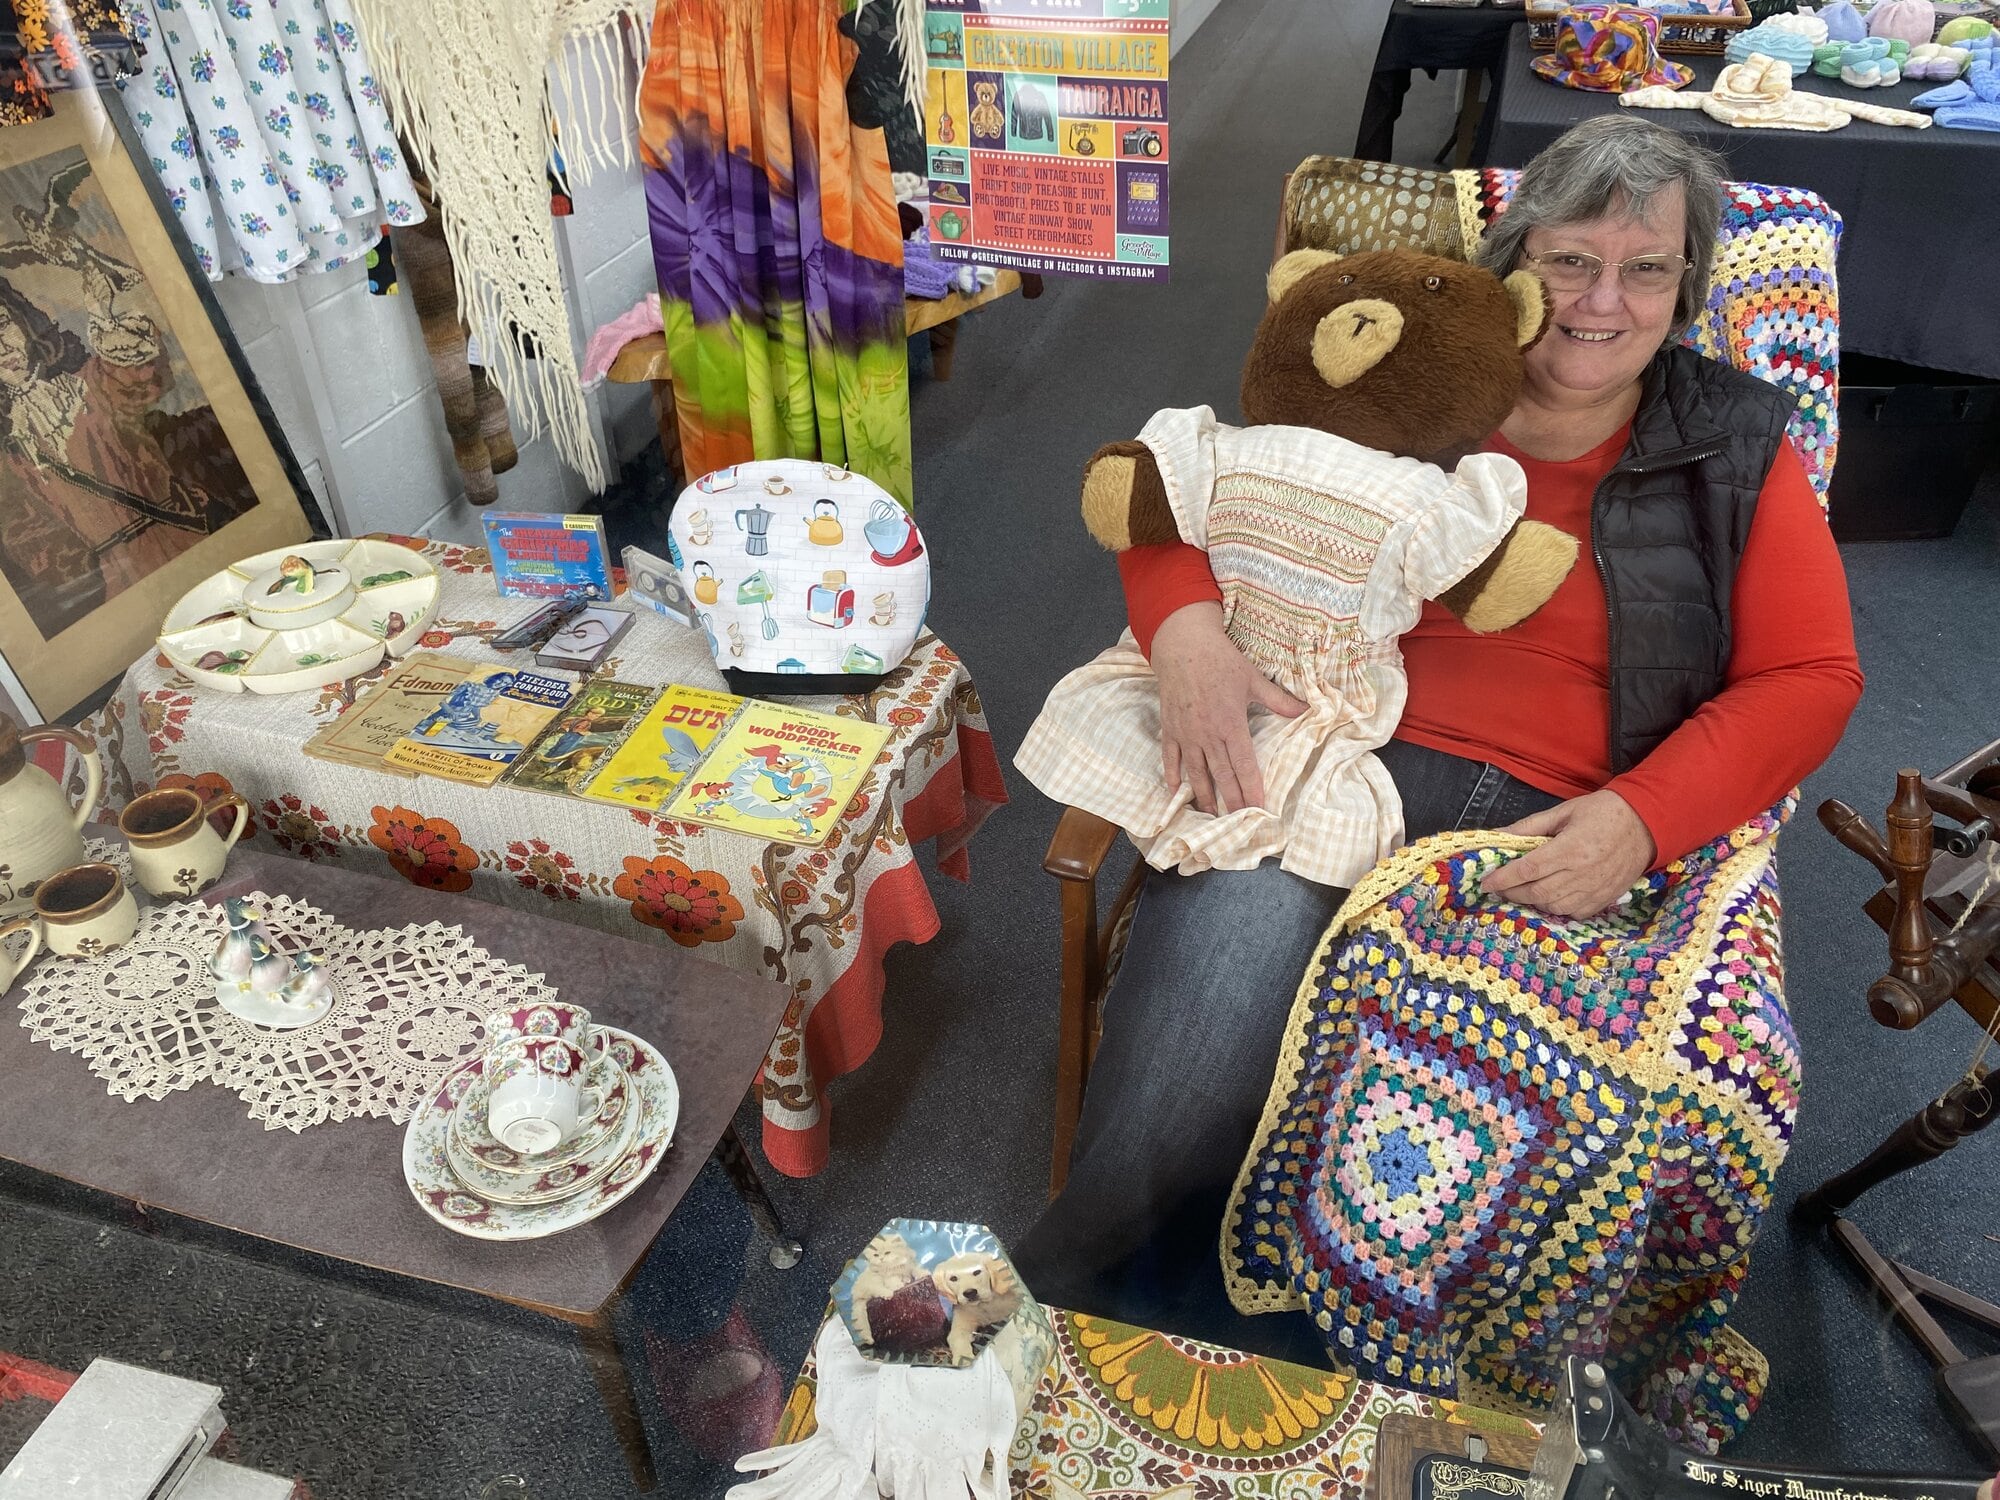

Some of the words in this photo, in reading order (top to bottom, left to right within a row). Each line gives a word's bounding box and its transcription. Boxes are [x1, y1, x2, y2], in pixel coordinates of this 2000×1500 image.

[972, 34, 1065, 69] GREERTON
[1072, 38, 1162, 77] VILLAGE,
[1061, 83, 1163, 118] TAURANGA
[983, 163, 1000, 176] LIVE
[1034, 167, 1068, 183] VINTAGE
[1071, 171, 1104, 185] STALLS
[980, 178, 1008, 192] THRIFT
[1011, 181, 1032, 194] SHOP
[1035, 183, 1078, 199] TREASURE
[1030, 198, 1060, 212] PRIZES
[1063, 201, 1073, 213] TO
[1076, 203, 1086, 215] BE
[1090, 204, 1111, 216] WON
[993, 209, 1025, 224] VINTAGE
[1029, 213, 1064, 228] RUNWAY
[994, 224, 1024, 239] STREET
[1027, 228, 1093, 246] PERFORMANCES
[940, 247, 968, 259] FOLLOW
[971, 252, 1042, 269] @GREERTONVILLAGE
[1044, 260, 1054, 270] ON
[1057, 261, 1094, 275] FACEBOOK
[1098, 265, 1104, 275] &
[1107, 266, 1155, 278] INSTAGRAM
[499, 527, 512, 537] The
[513, 681, 569, 699] CORNFLOUR
[520, 674, 567, 691] FIELDER
[587, 696, 626, 709] OLD
[748, 724, 862, 755] WOODPECKER
[781, 722, 842, 740] WOODY
[811, 747, 827, 756] the
[828, 751, 857, 761] Circus
[466, 762, 494, 771] WOMAN
[1684, 1461, 1718, 1485] The
